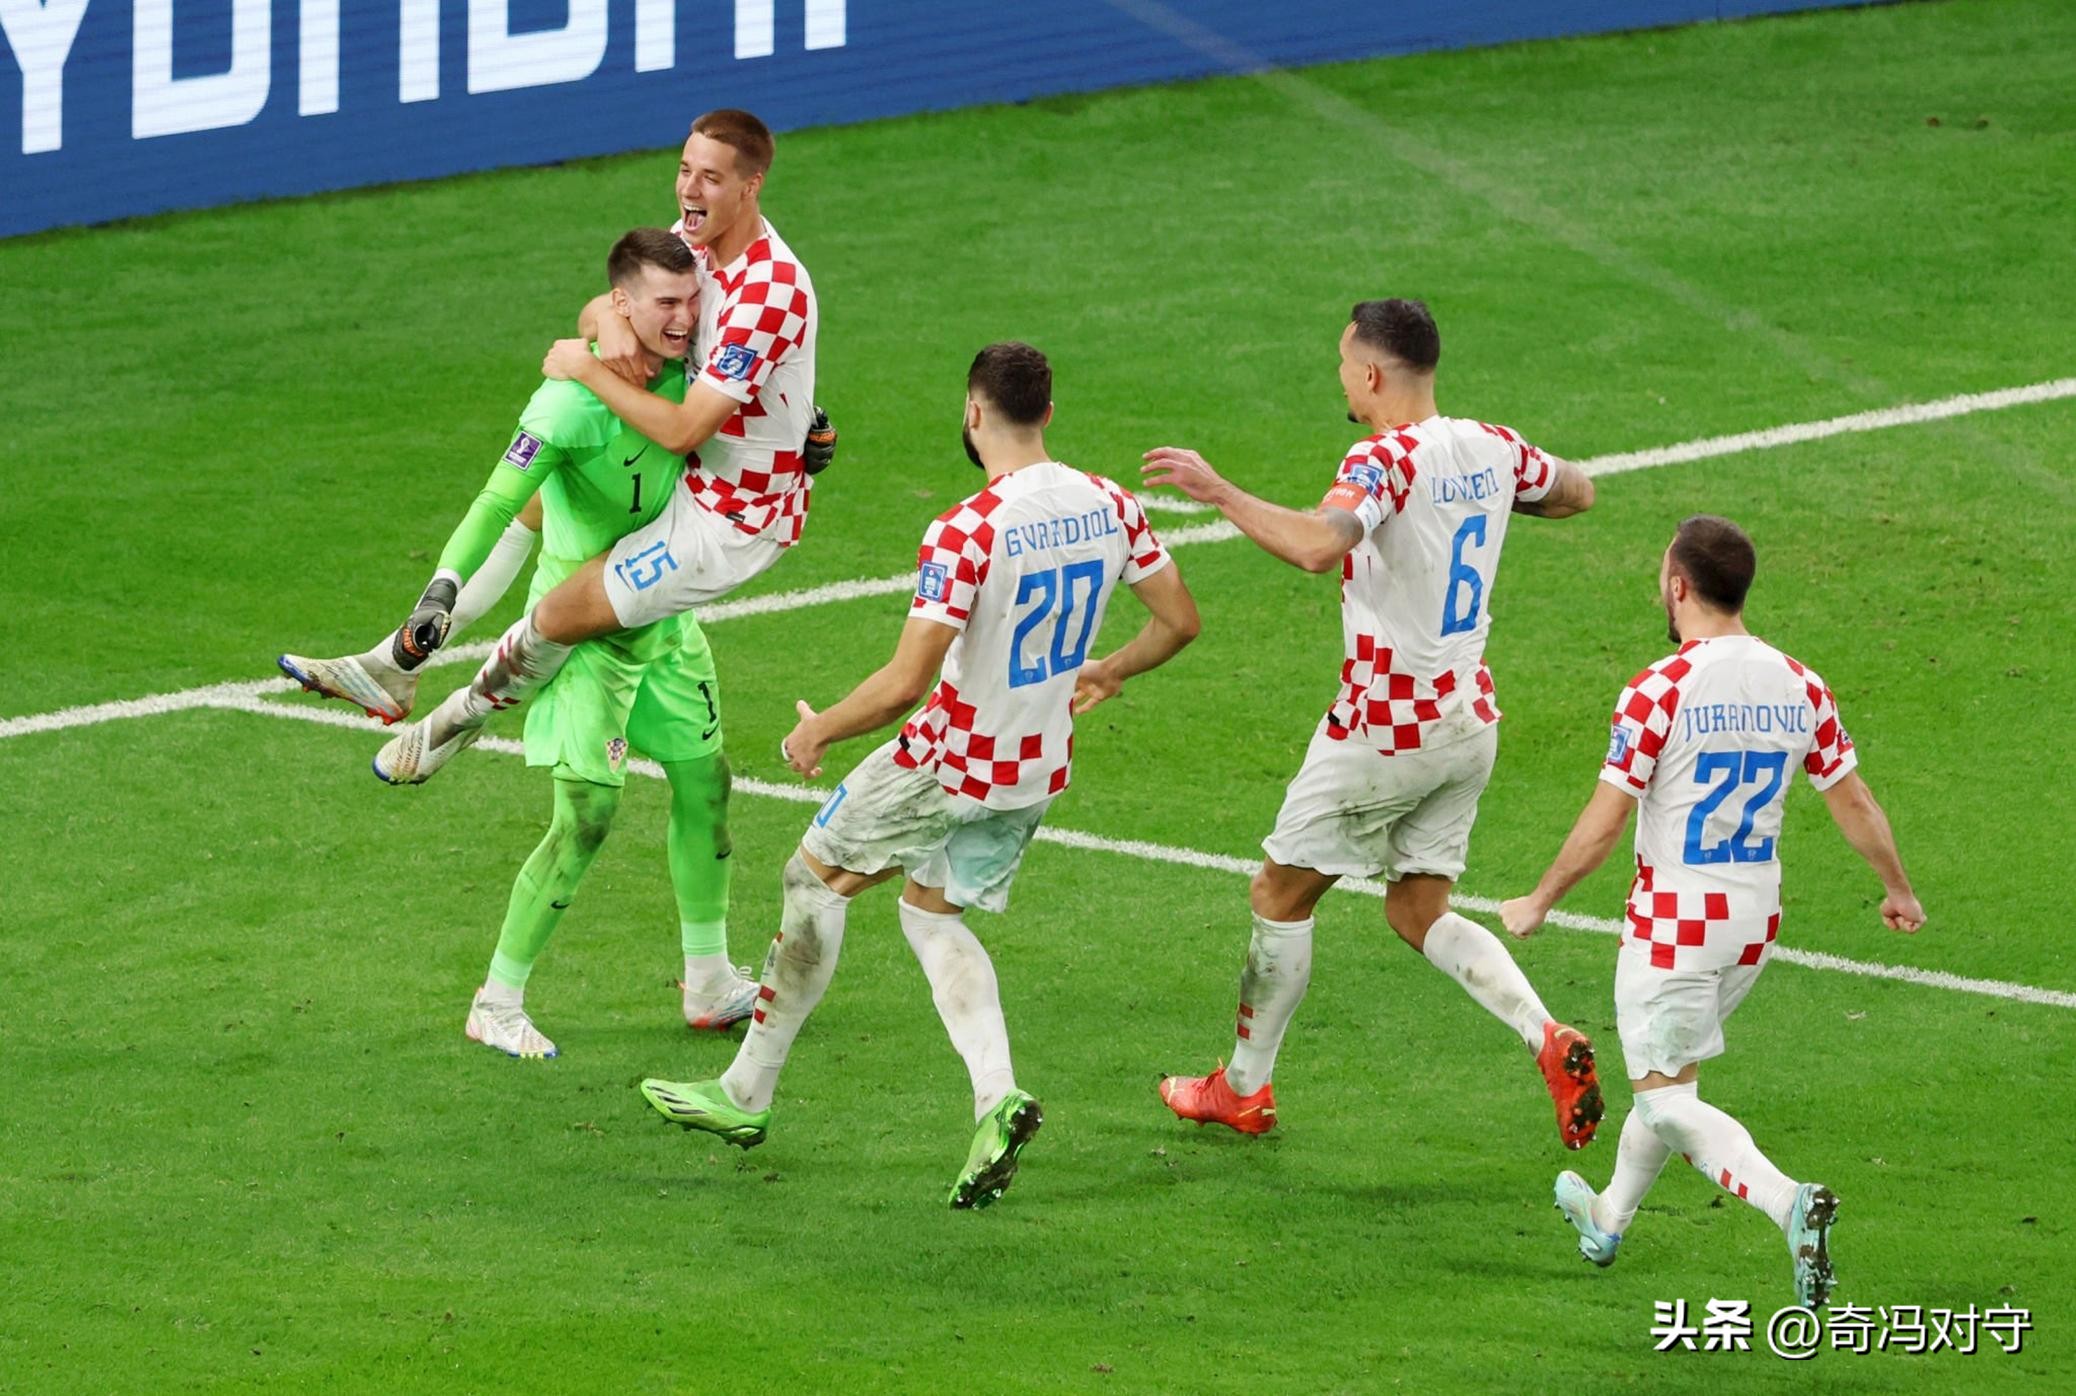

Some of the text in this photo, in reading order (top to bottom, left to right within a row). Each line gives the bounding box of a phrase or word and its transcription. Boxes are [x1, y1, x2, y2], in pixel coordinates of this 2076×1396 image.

[628, 472, 642, 514] 1
[625, 540, 679, 592] 15
[1440, 513, 1488, 638] 6
[1008, 558, 1105, 689] 20
[697, 681, 718, 723] 1
[1682, 750, 1789, 865] 22
